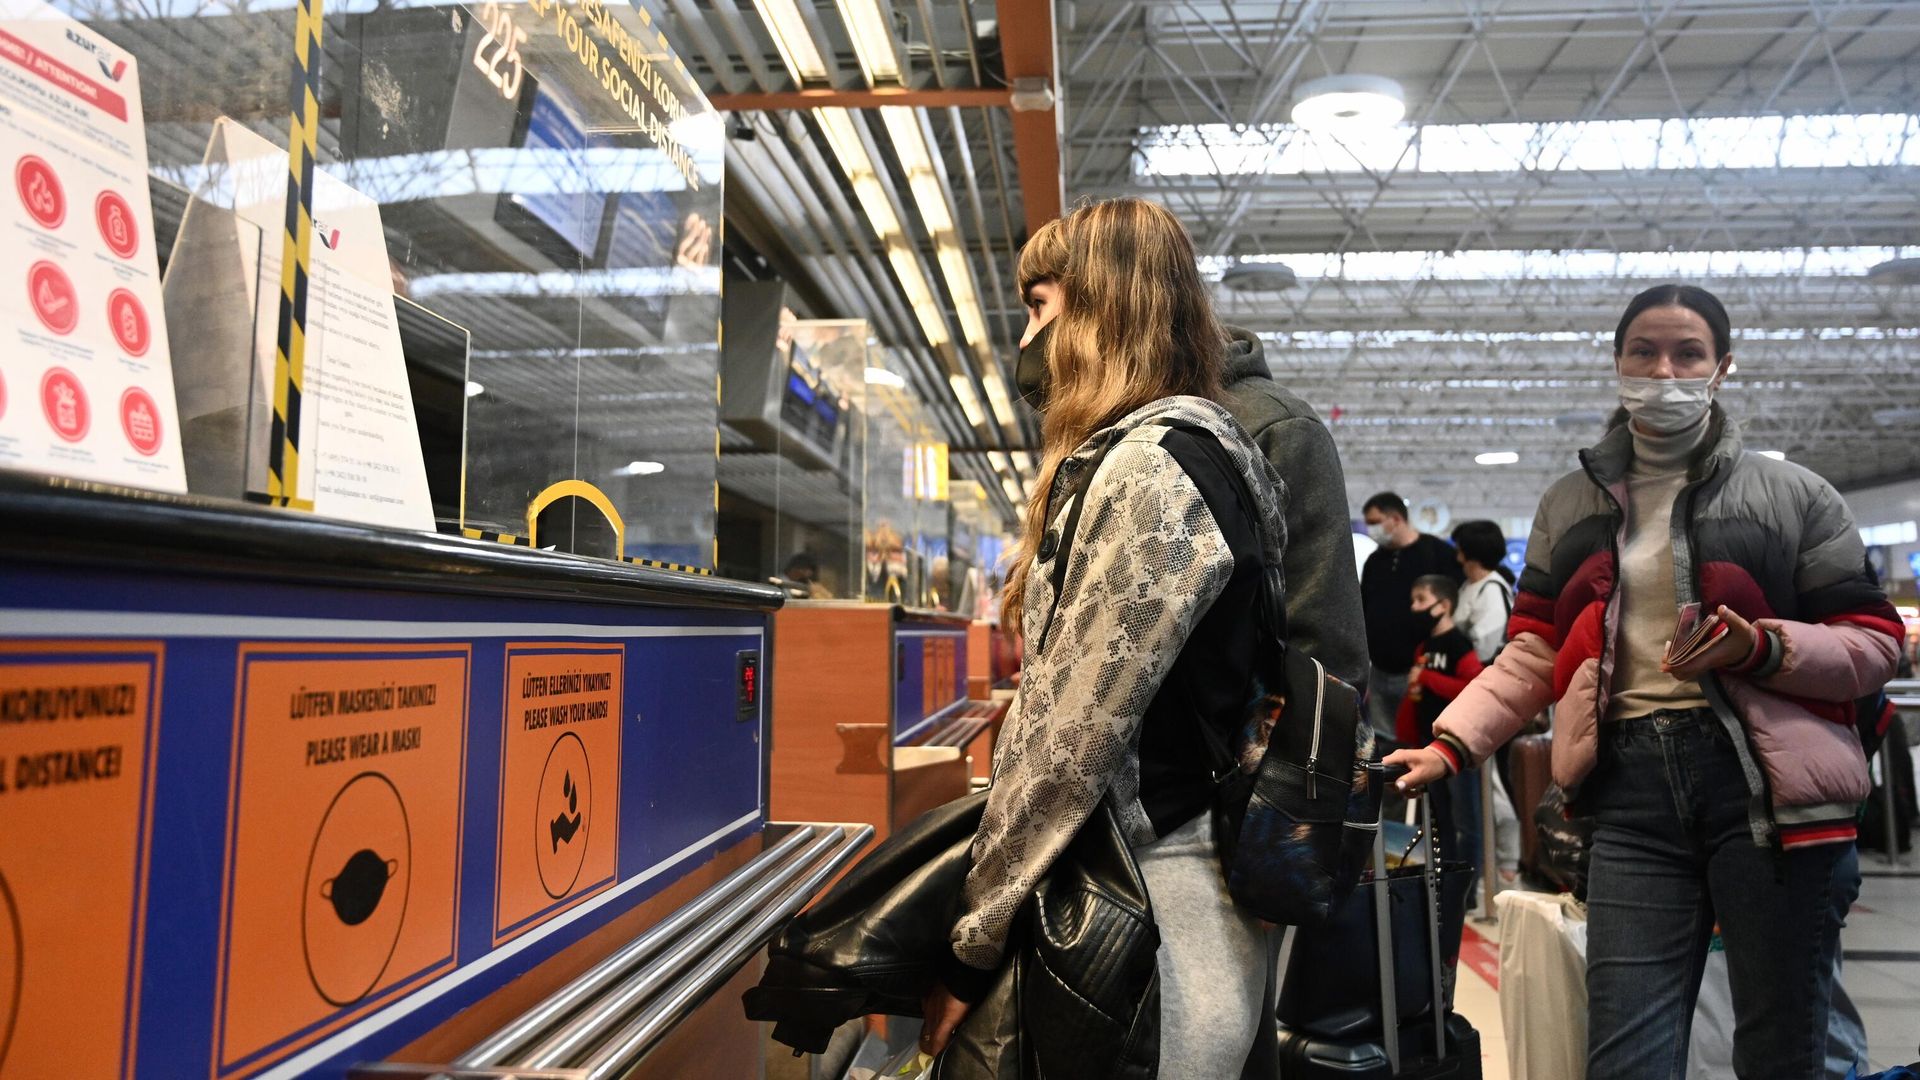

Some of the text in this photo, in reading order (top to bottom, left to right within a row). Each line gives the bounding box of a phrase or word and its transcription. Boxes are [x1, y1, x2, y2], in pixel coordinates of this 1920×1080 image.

[473, 0, 527, 99] 225
[556, 0, 600, 79] YOUR
[601, 57, 648, 134] SOCIAL
[650, 112, 699, 191] DISTANCE
[290, 686, 335, 719] LÜTFEN
[522, 672, 548, 698] LÜTFEN
[524, 700, 608, 731] PLEASE WASH YOUR HANDS!
[305, 726, 421, 766] PLEASE WEAR A MASK!
[16, 746, 122, 790] DISTANCE!
